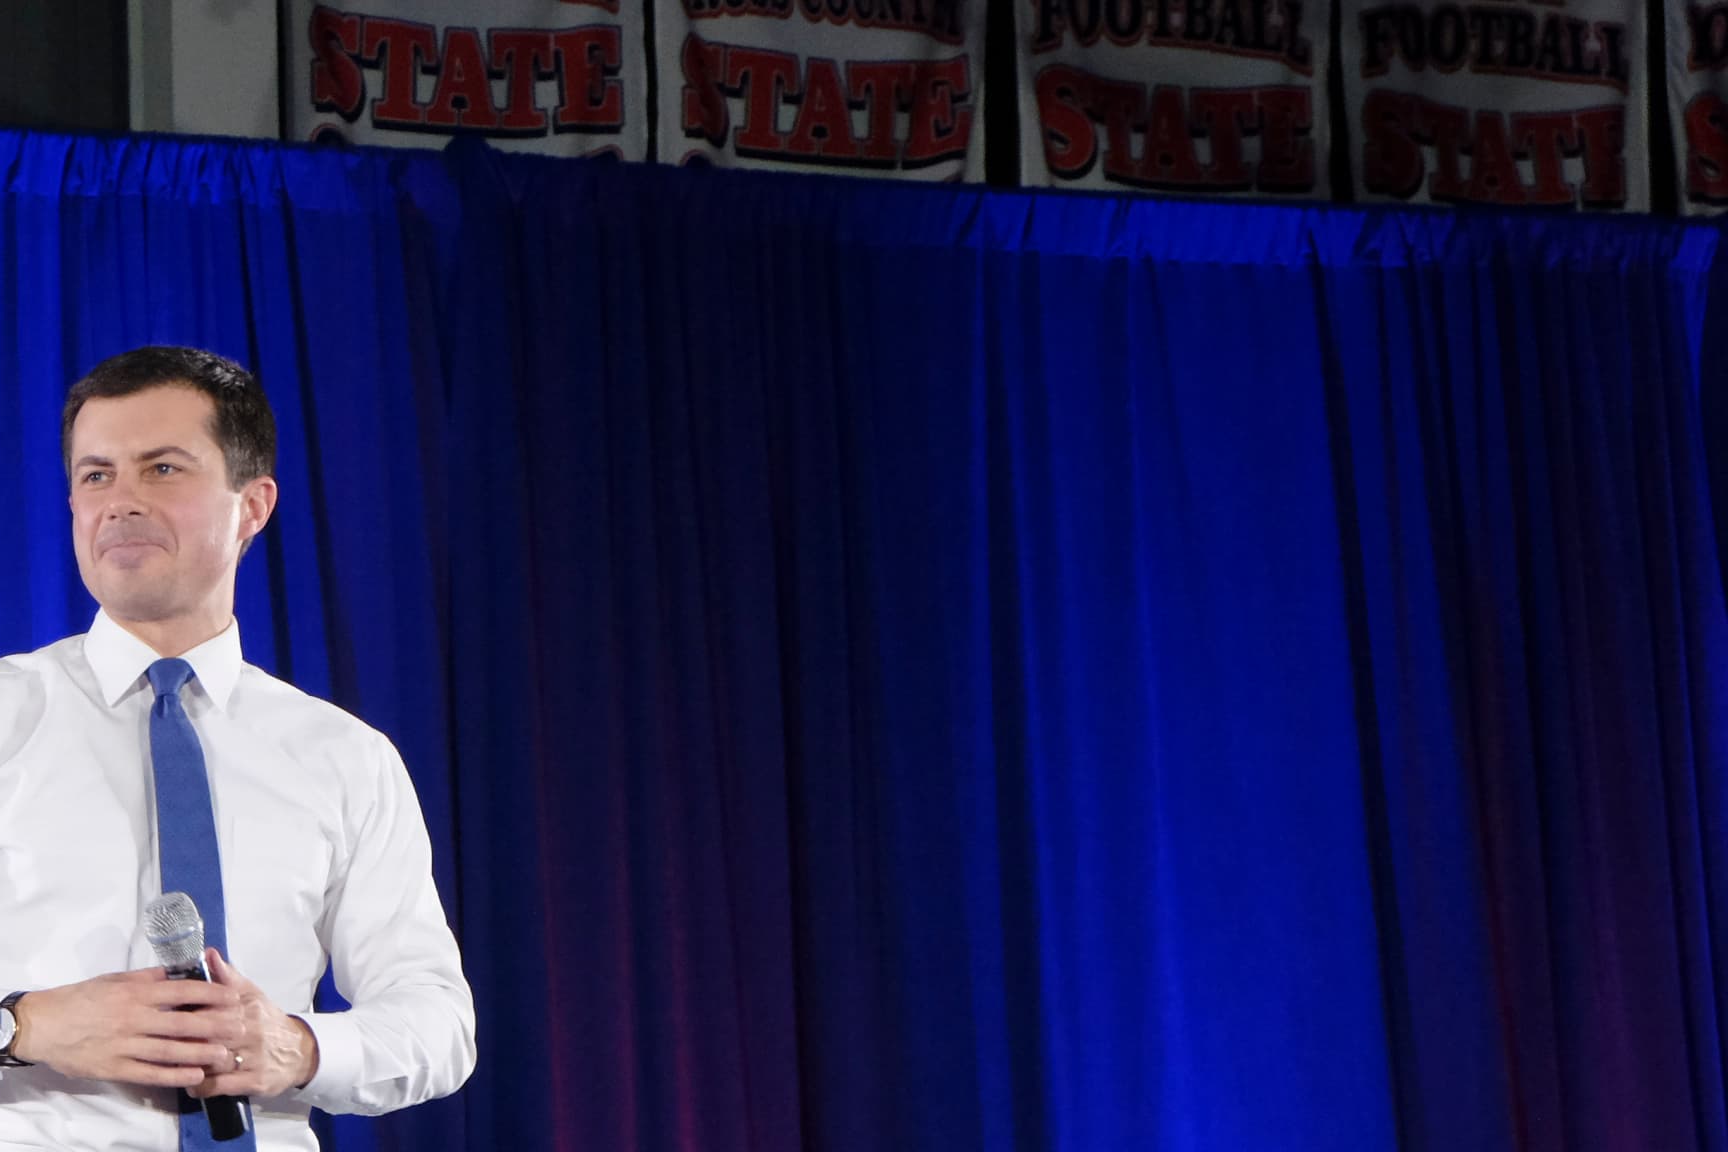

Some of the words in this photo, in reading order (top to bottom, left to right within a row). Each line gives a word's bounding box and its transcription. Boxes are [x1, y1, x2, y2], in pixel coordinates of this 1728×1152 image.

[310, 5, 624, 137] STATE
[682, 32, 972, 170] STATE
[1034, 62, 1313, 193] STATE
